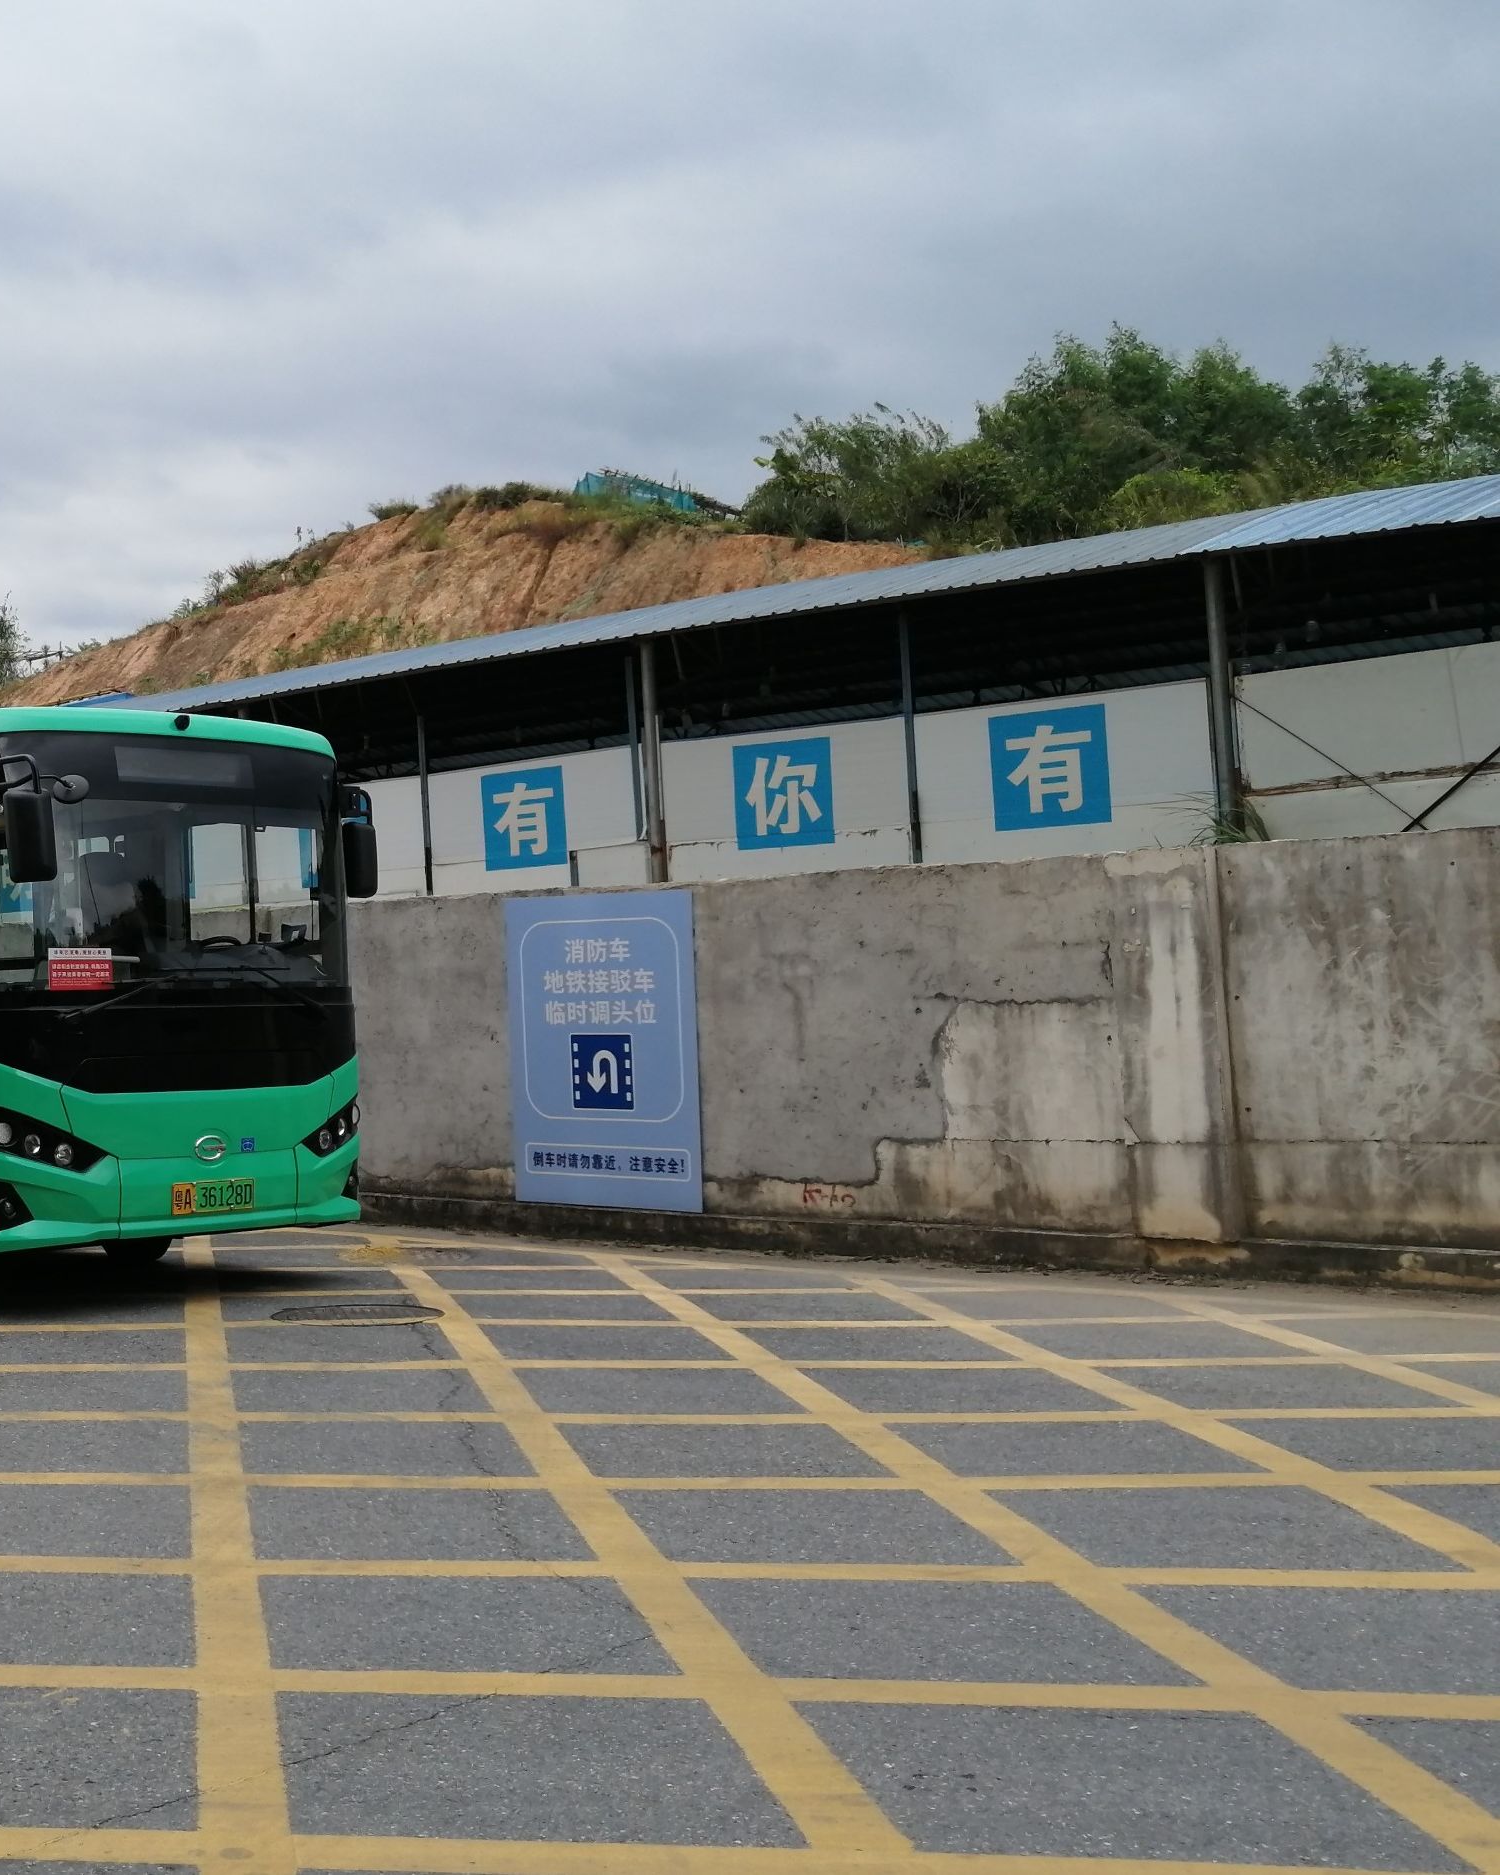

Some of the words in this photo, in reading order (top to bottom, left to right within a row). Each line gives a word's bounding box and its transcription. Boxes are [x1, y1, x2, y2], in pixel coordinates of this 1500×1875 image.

[492, 782, 555, 857] 有
[744, 754, 824, 837] 你
[1004, 724, 1092, 814] 有
[564, 937, 631, 964] 消防车
[543, 967, 656, 995] 地铁接驳车
[545, 999, 657, 1025] 临时调头位
